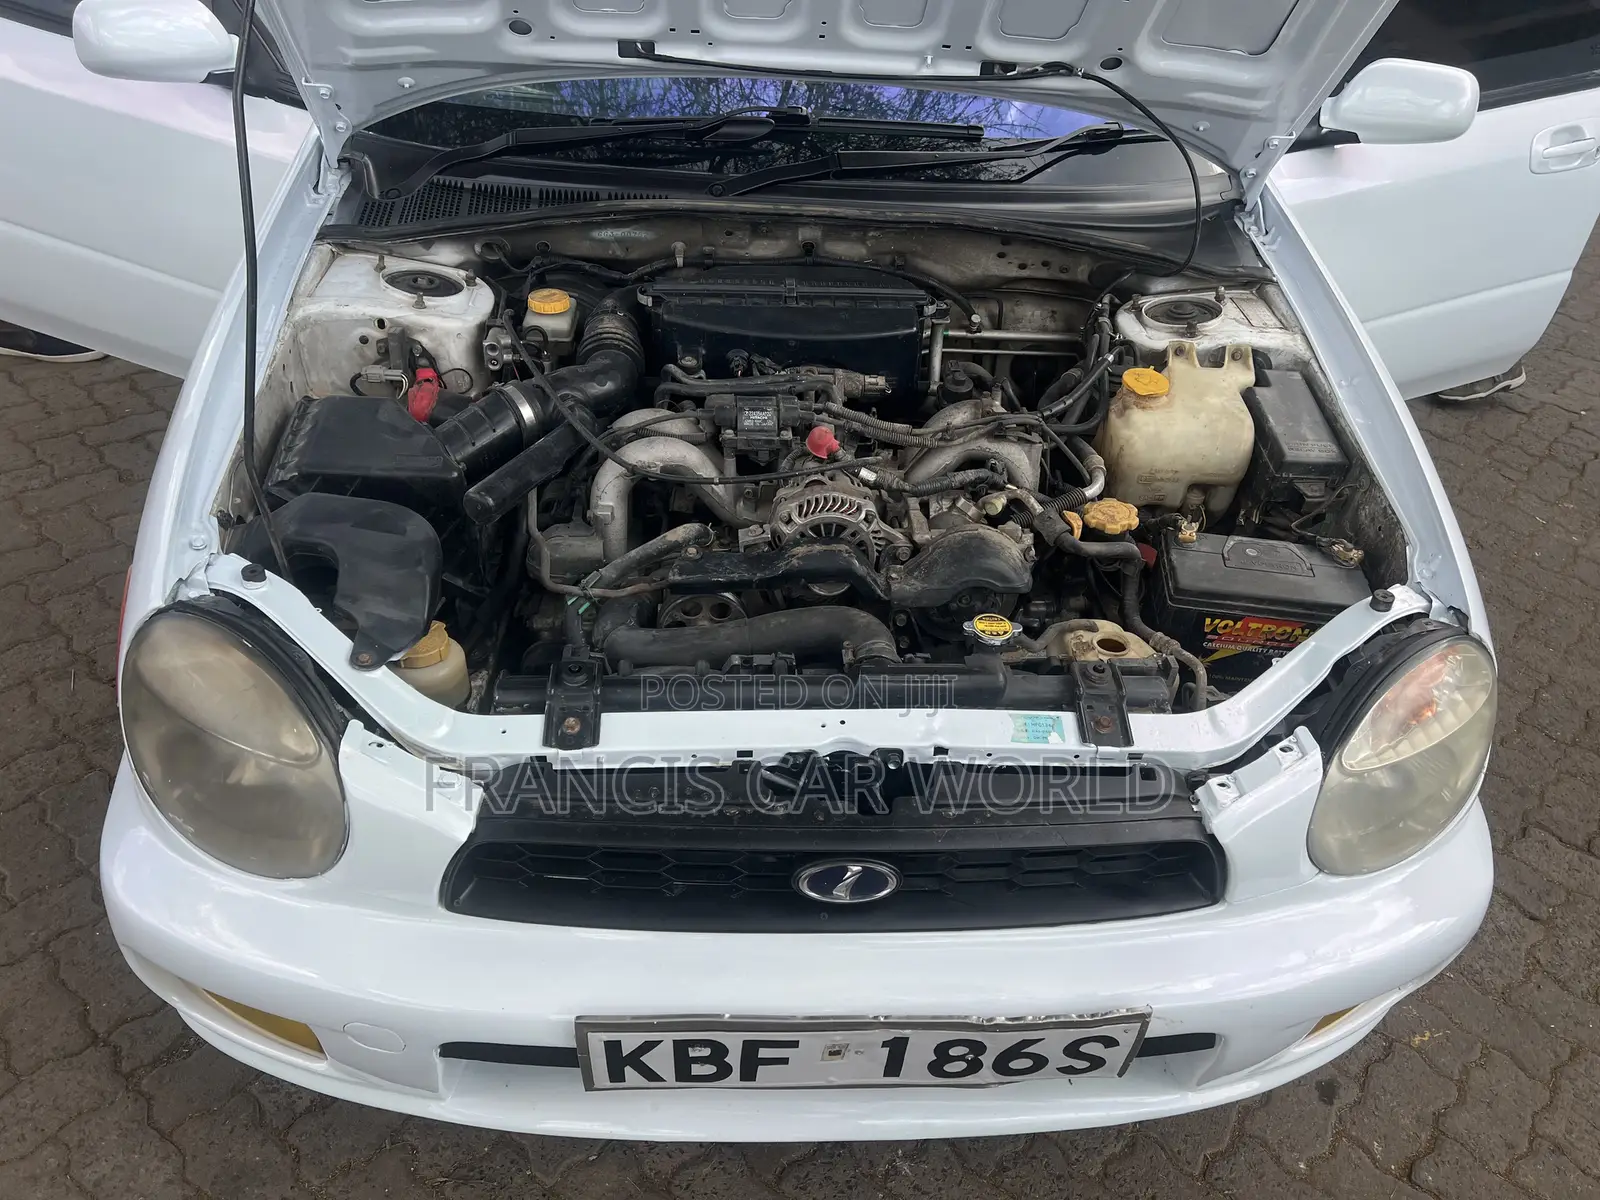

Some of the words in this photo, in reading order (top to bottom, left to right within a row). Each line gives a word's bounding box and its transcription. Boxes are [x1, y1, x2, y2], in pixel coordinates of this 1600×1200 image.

[1204, 617, 1312, 644] VOLTRON
[1203, 641, 1235, 650] CALCIUM
[1236, 645, 1268, 654] QUALITY
[602, 1038, 800, 1084] KBF
[880, 1034, 1121, 1079] 186S
